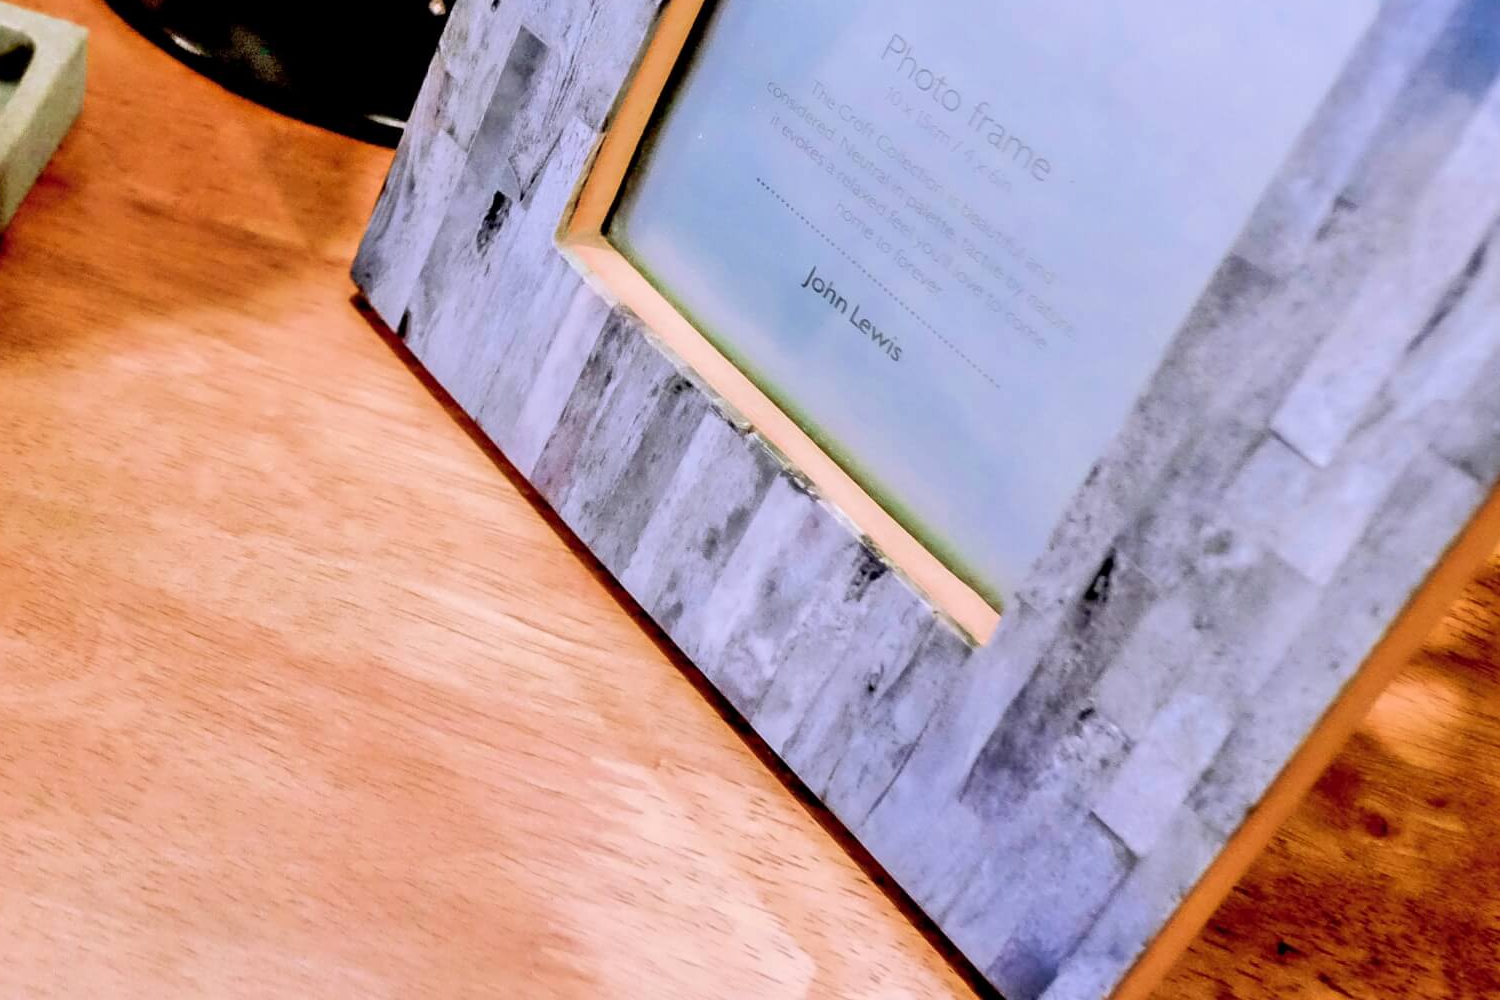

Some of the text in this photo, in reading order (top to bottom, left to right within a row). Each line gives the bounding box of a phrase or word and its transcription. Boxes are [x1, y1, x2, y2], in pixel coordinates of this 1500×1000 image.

[810, 80, 838, 110] The
[836, 103, 876, 139] Croft
[879, 32, 1053, 183] Photo frame
[780, 124, 827, 166] evokes
[835, 170, 888, 216] relaxed
[838, 136, 892, 186] Neutral
[834, 202, 876, 240] home
[874, 236, 893, 254] to
[799, 265, 903, 363] John Lewis
